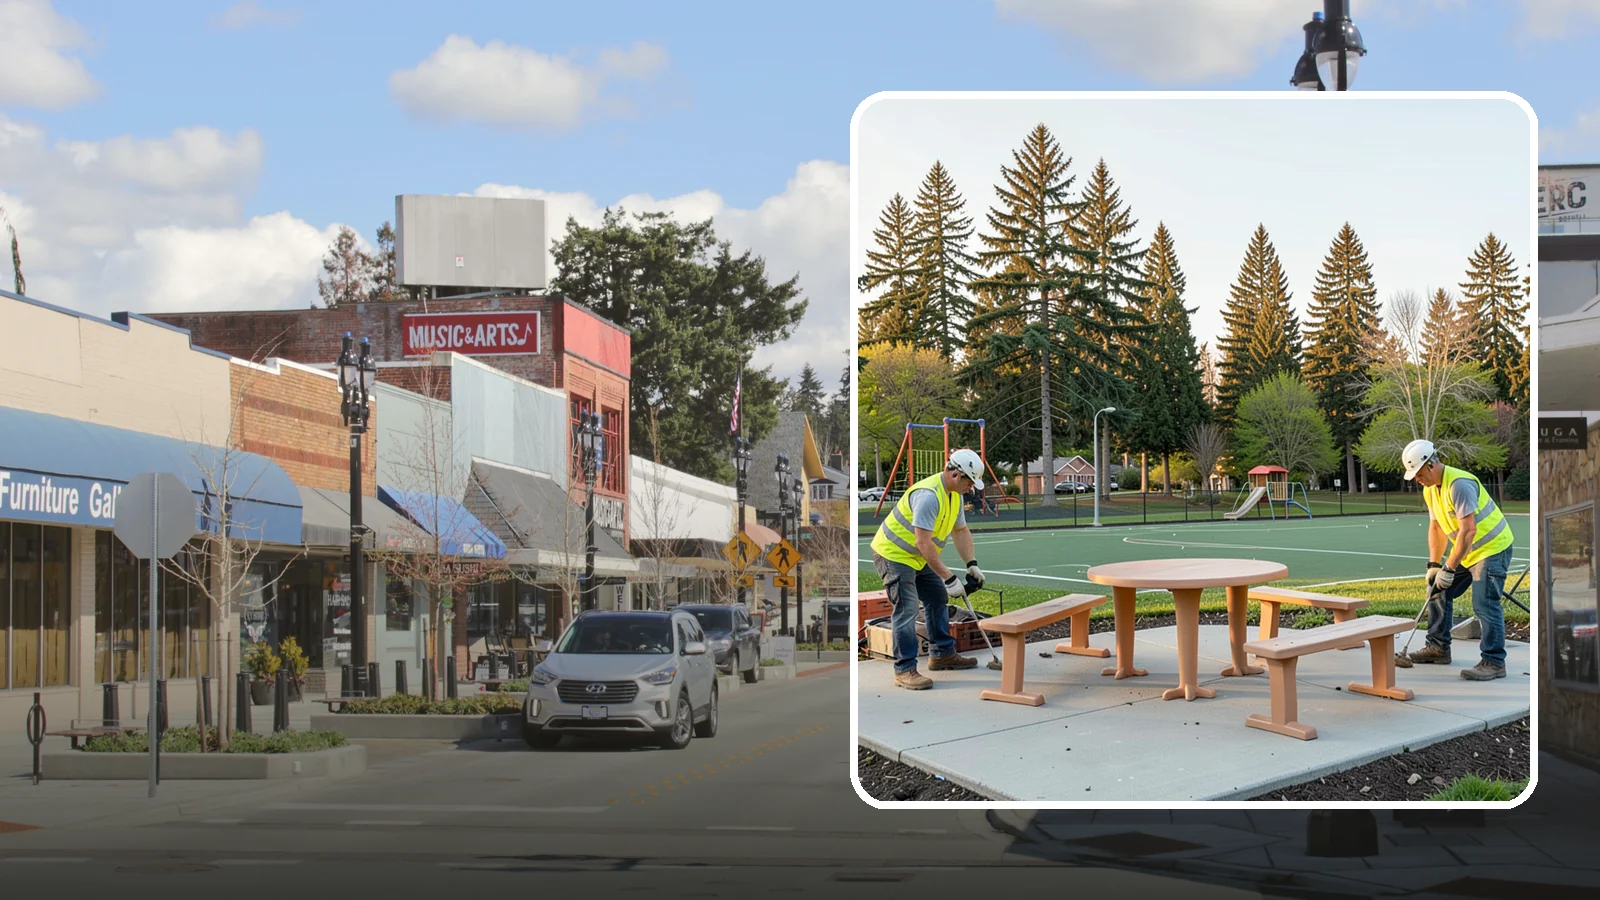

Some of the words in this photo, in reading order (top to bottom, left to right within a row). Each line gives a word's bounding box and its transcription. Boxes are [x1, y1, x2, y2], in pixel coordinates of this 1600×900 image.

[0, 472, 79, 515] Furniture
[90, 483, 121, 519] Gal
[453, 563, 479, 574] SUSHI
